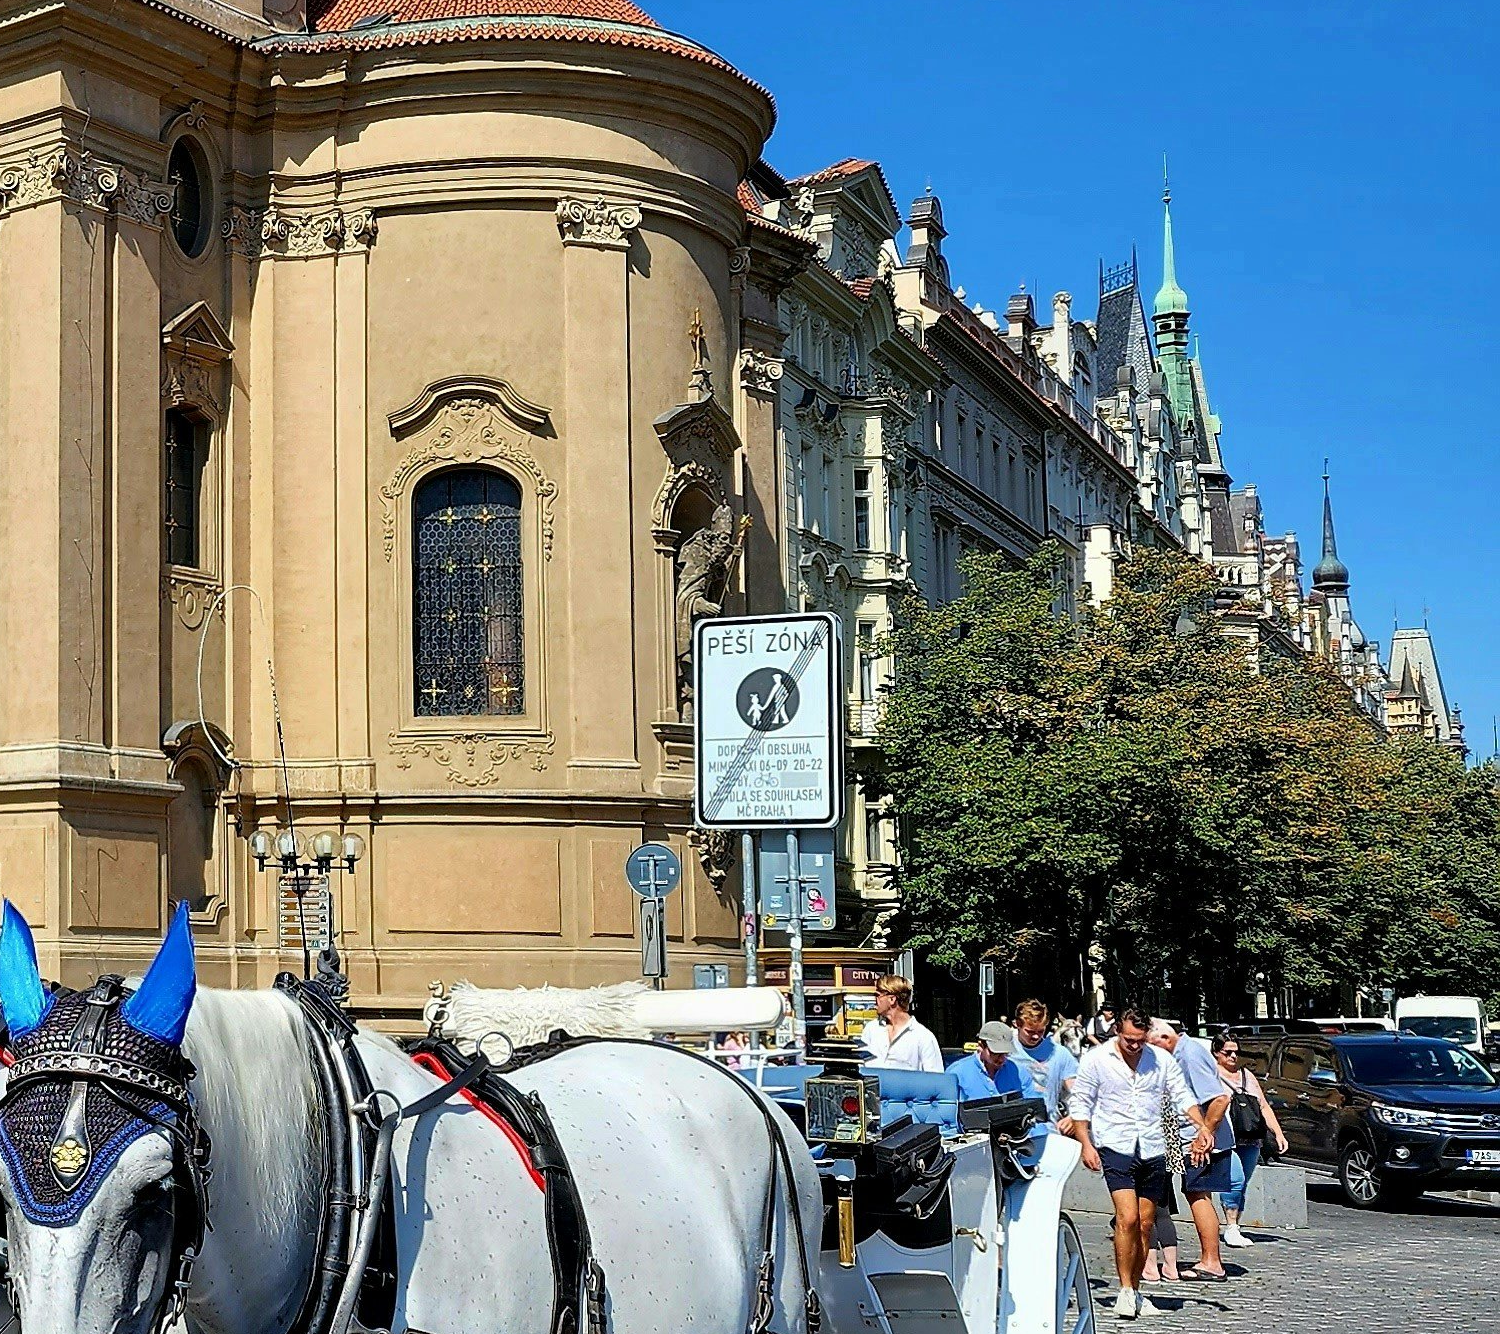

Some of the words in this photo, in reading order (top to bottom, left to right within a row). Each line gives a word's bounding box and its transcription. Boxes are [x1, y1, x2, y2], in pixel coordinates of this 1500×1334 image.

[708, 629, 754, 656] PĚŠÍ
[765, 626, 824, 653] ZÓNA
[767, 743, 812, 755] OBSLUHA
[759, 760, 788, 771] 06-09
[793, 758, 823, 770] 20-22
[750, 790, 762, 802] SE
[764, 788, 823, 801] SOUHLASEM
[736, 803, 752, 817] MČ
[754, 804, 786, 817] PRAHA
[788, 804, 794, 816] 1
[852, 970, 869, 980] CITY
